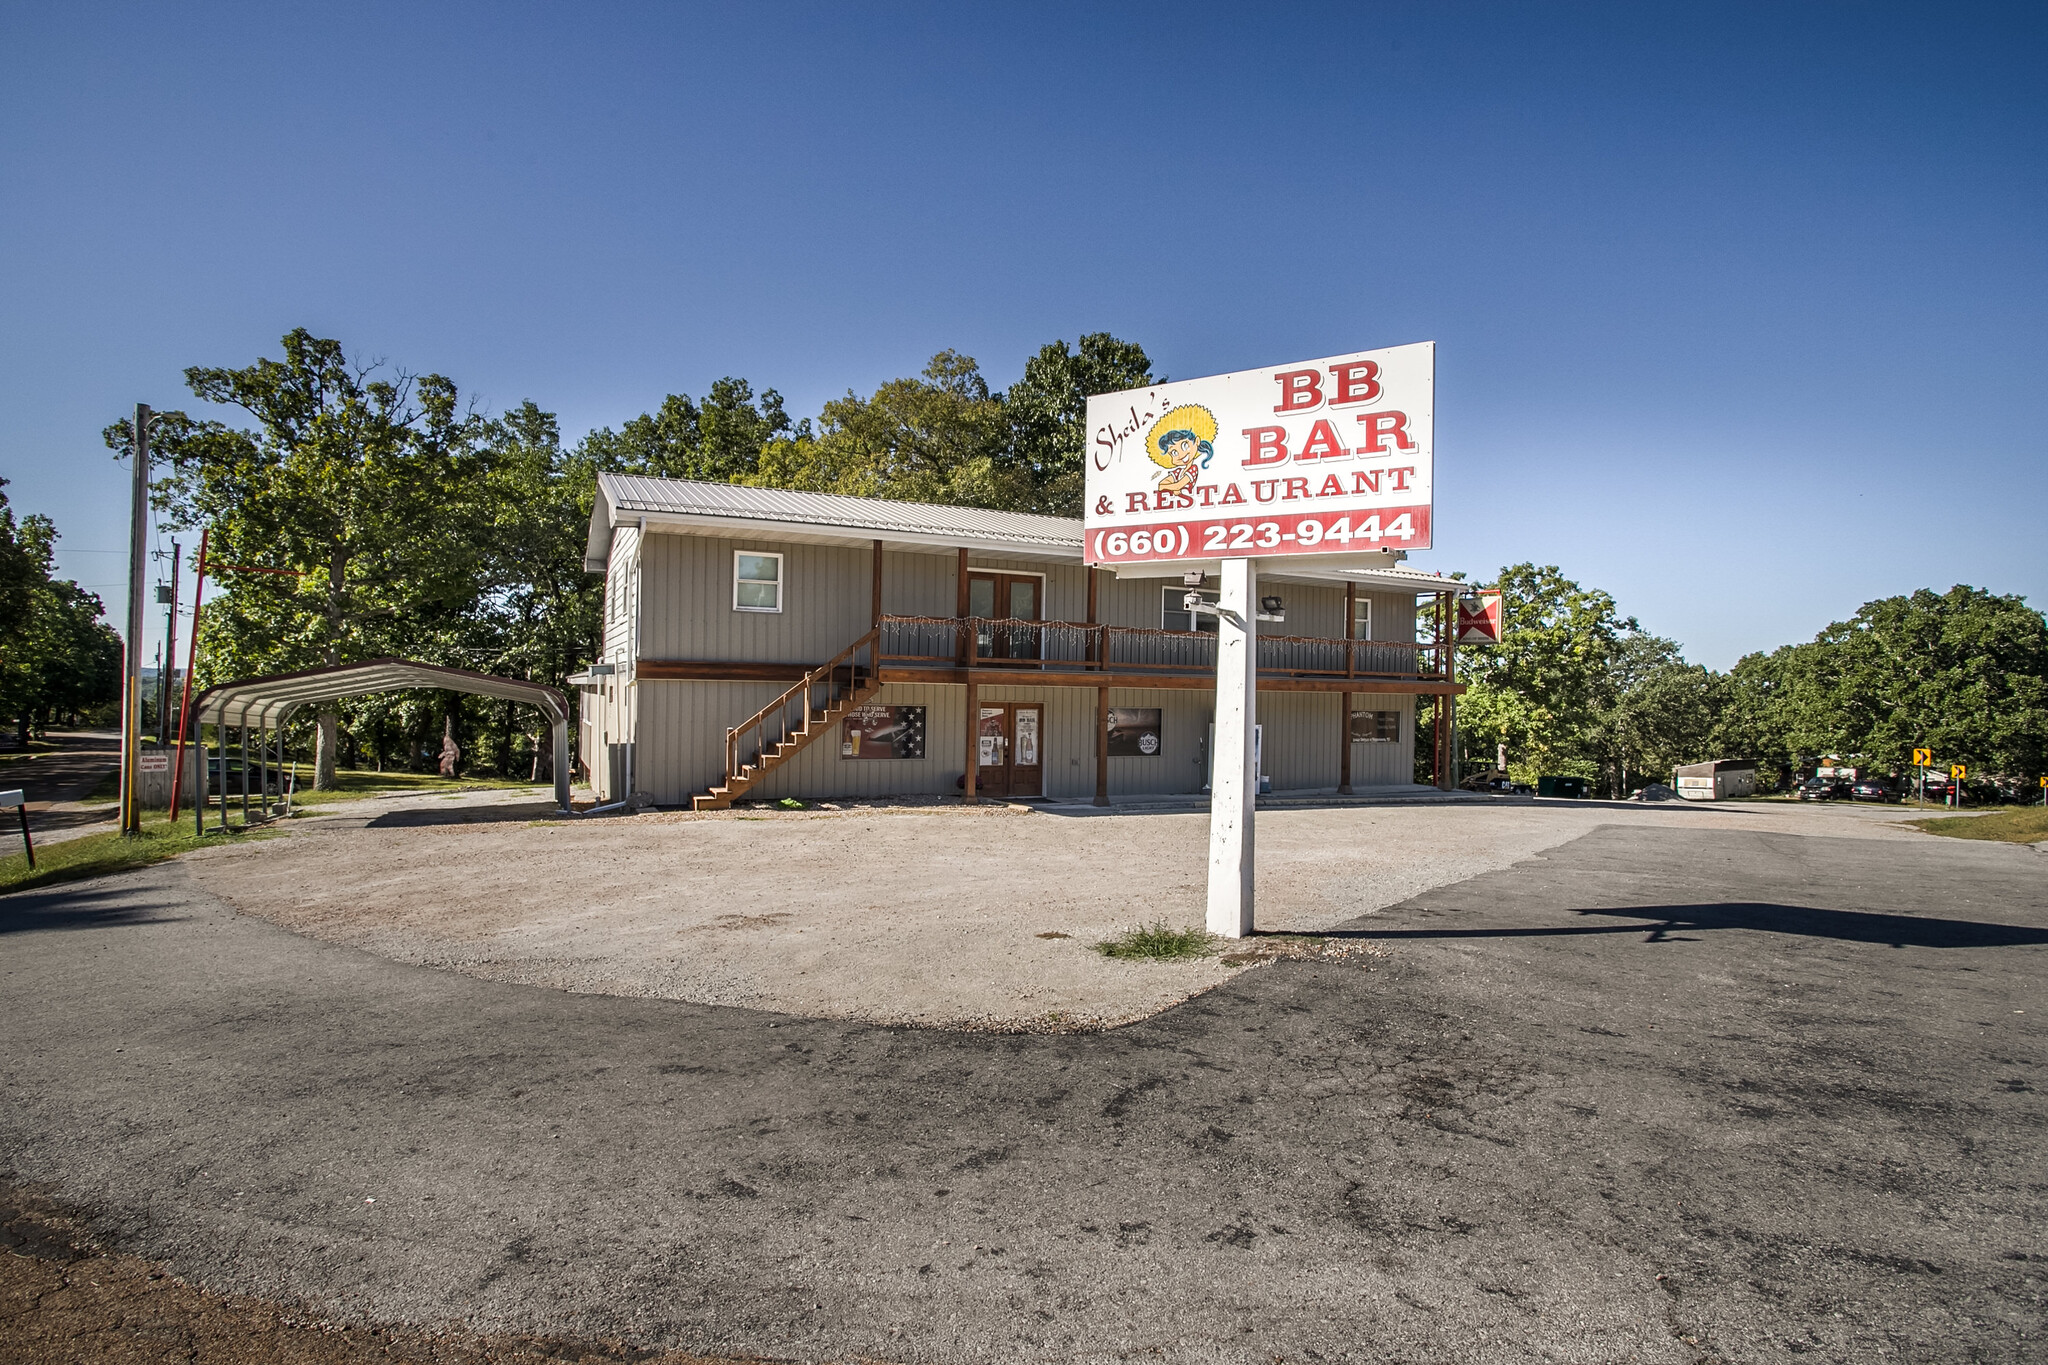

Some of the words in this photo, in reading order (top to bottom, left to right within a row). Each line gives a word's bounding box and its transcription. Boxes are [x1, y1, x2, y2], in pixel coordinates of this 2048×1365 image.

[1273, 360, 1383, 415] BB
[1094, 391, 1170, 471] Sheila's
[1241, 410, 1418, 469] BAR
[1095, 494, 1115, 516] &
[1125, 466, 1415, 513] RESTAURANT
[1093, 525, 1190, 559] (660)
[1203, 513, 1415, 550] 223-9444
[1460, 617, 1497, 625] Budweiser
[1138, 738, 1158, 746] BUSCH
[1502, 781, 1510, 789] CAT
